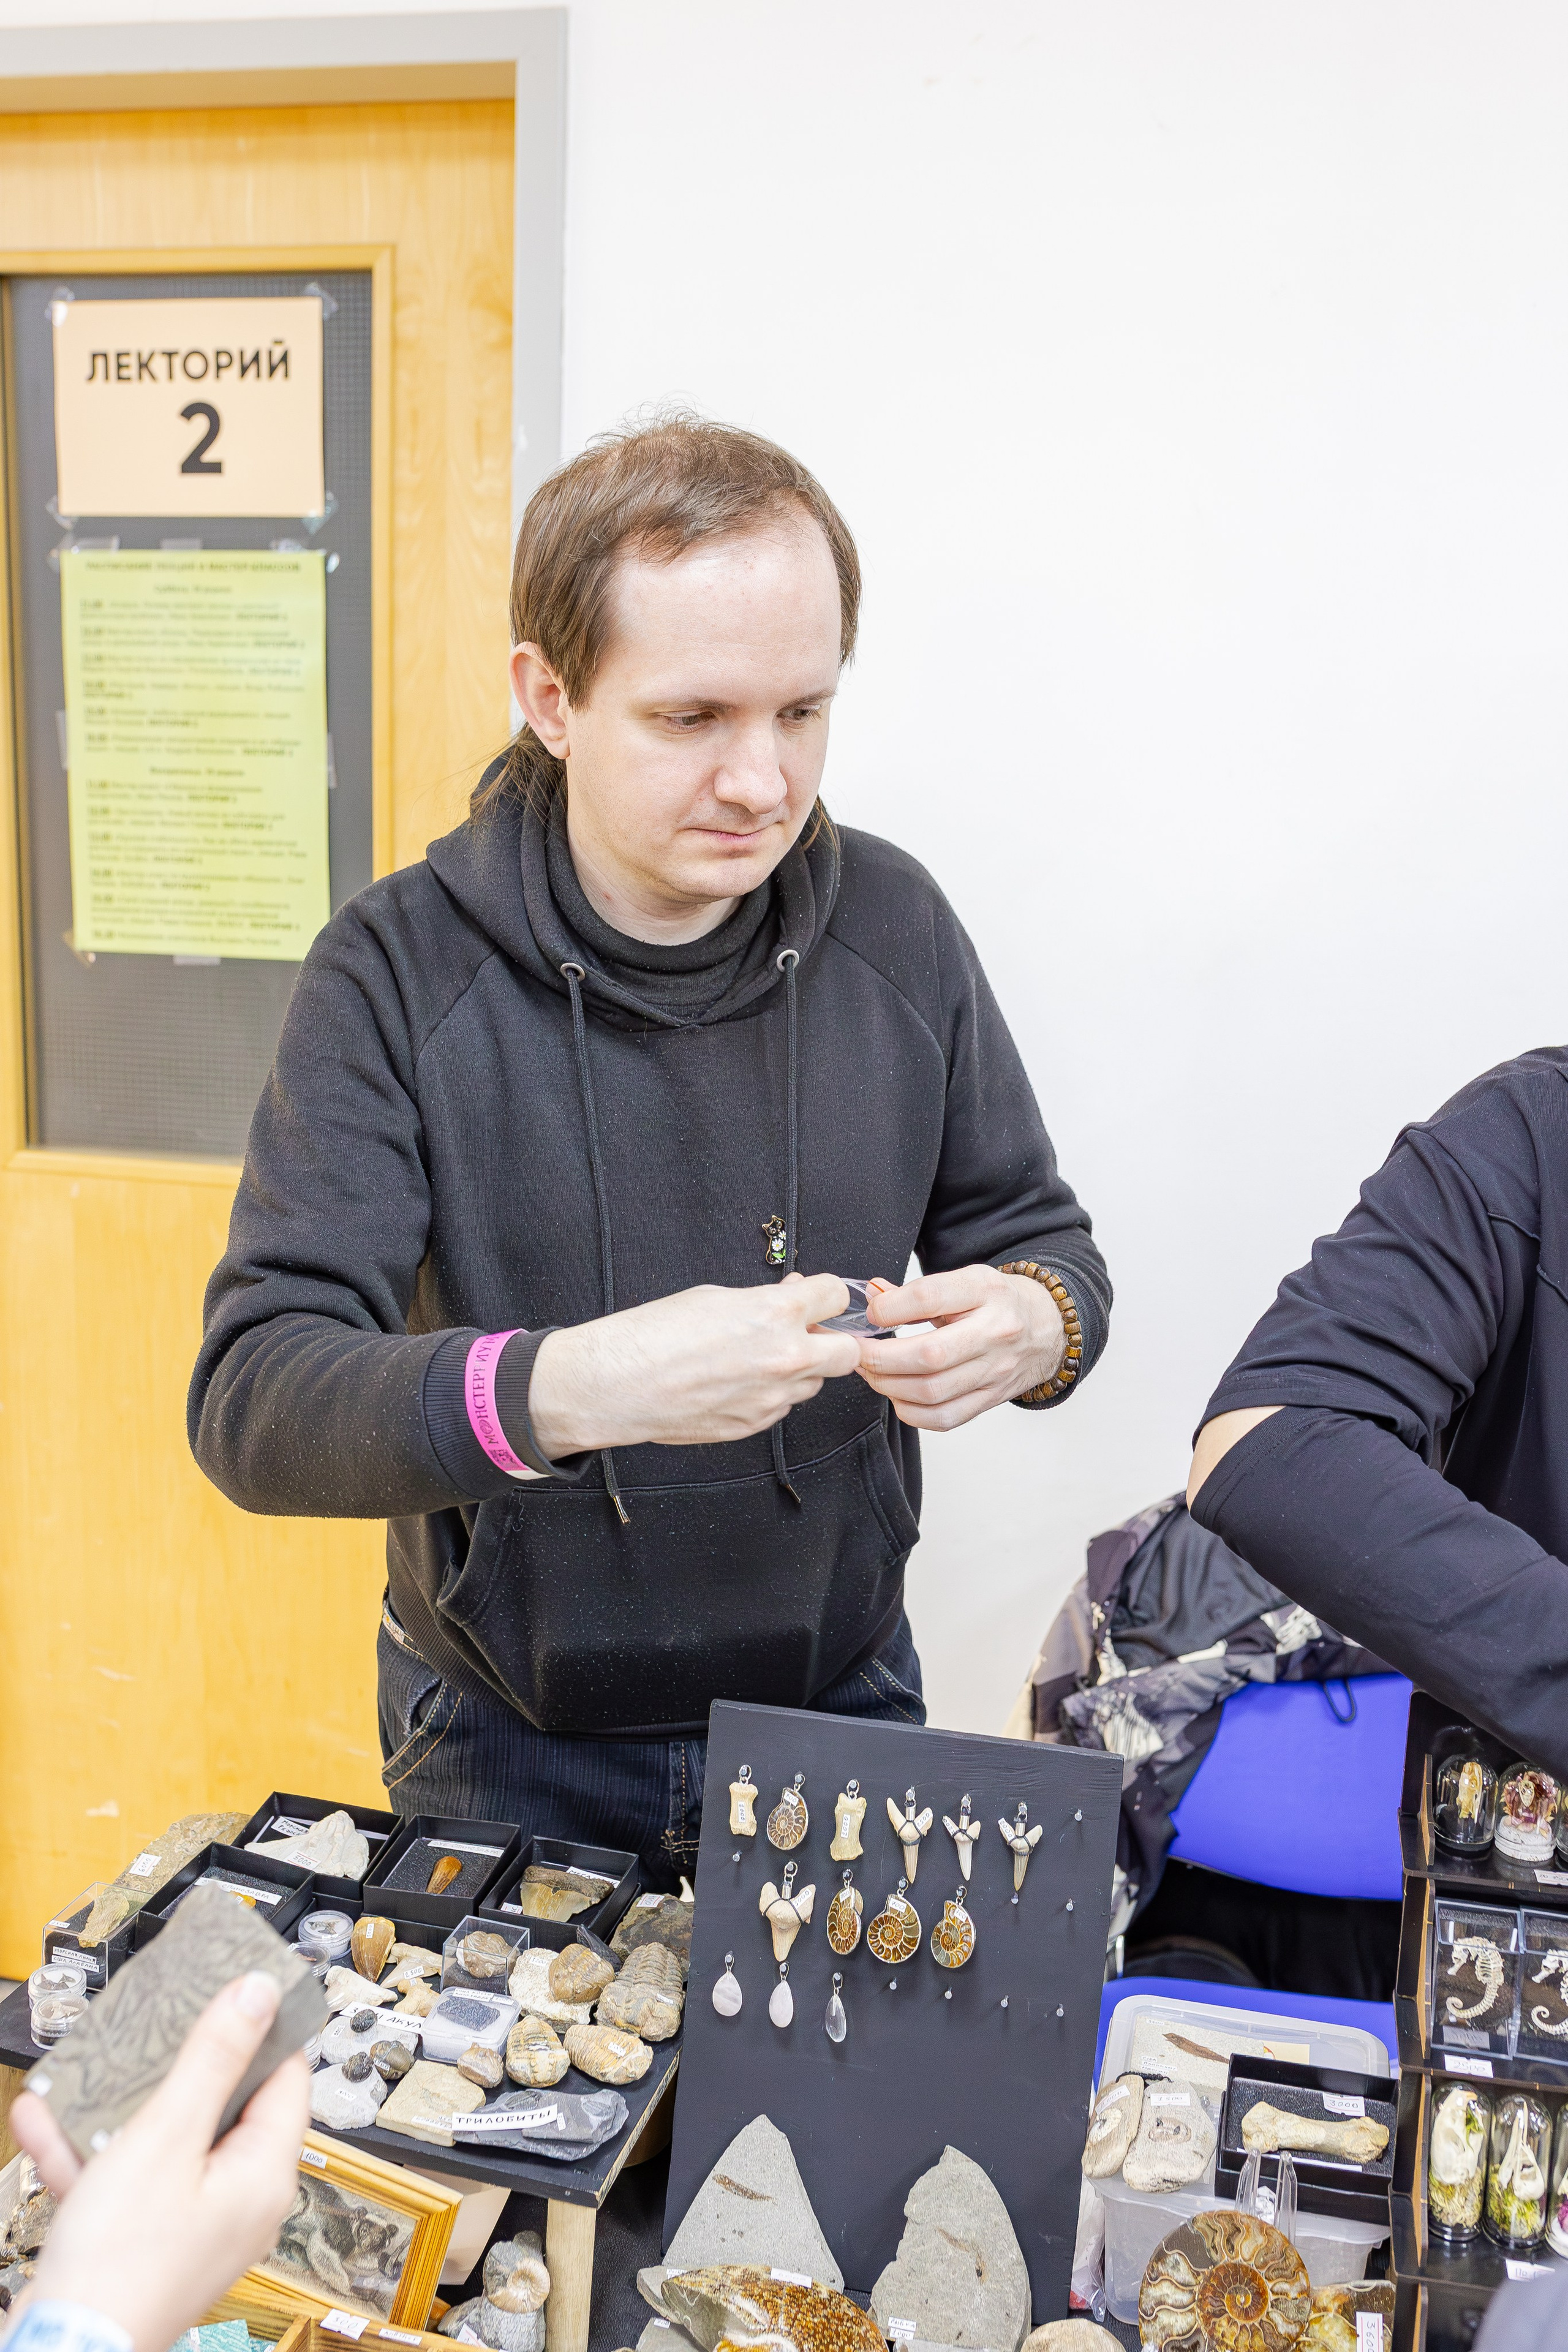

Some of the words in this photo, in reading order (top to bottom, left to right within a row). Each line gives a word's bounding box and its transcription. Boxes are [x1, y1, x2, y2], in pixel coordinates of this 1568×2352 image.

[86, 339, 290, 381] ЛЕКТОРИЙ
[180, 402, 222, 473] 2
[138, 1858, 151, 1873] 6000
[292, 1854, 311, 1866] 5000
[222, 1883, 270, 1899] СПИНОЗАВРА
[405, 1967, 423, 1978] 2500
[386, 2016, 422, 2029] АКУЛ
[1329, 2100, 1359, 2109] 3000
[455, 2109, 551, 2125] ТРИЛОБИТЫ
[305, 2152, 323, 2163] 1000
